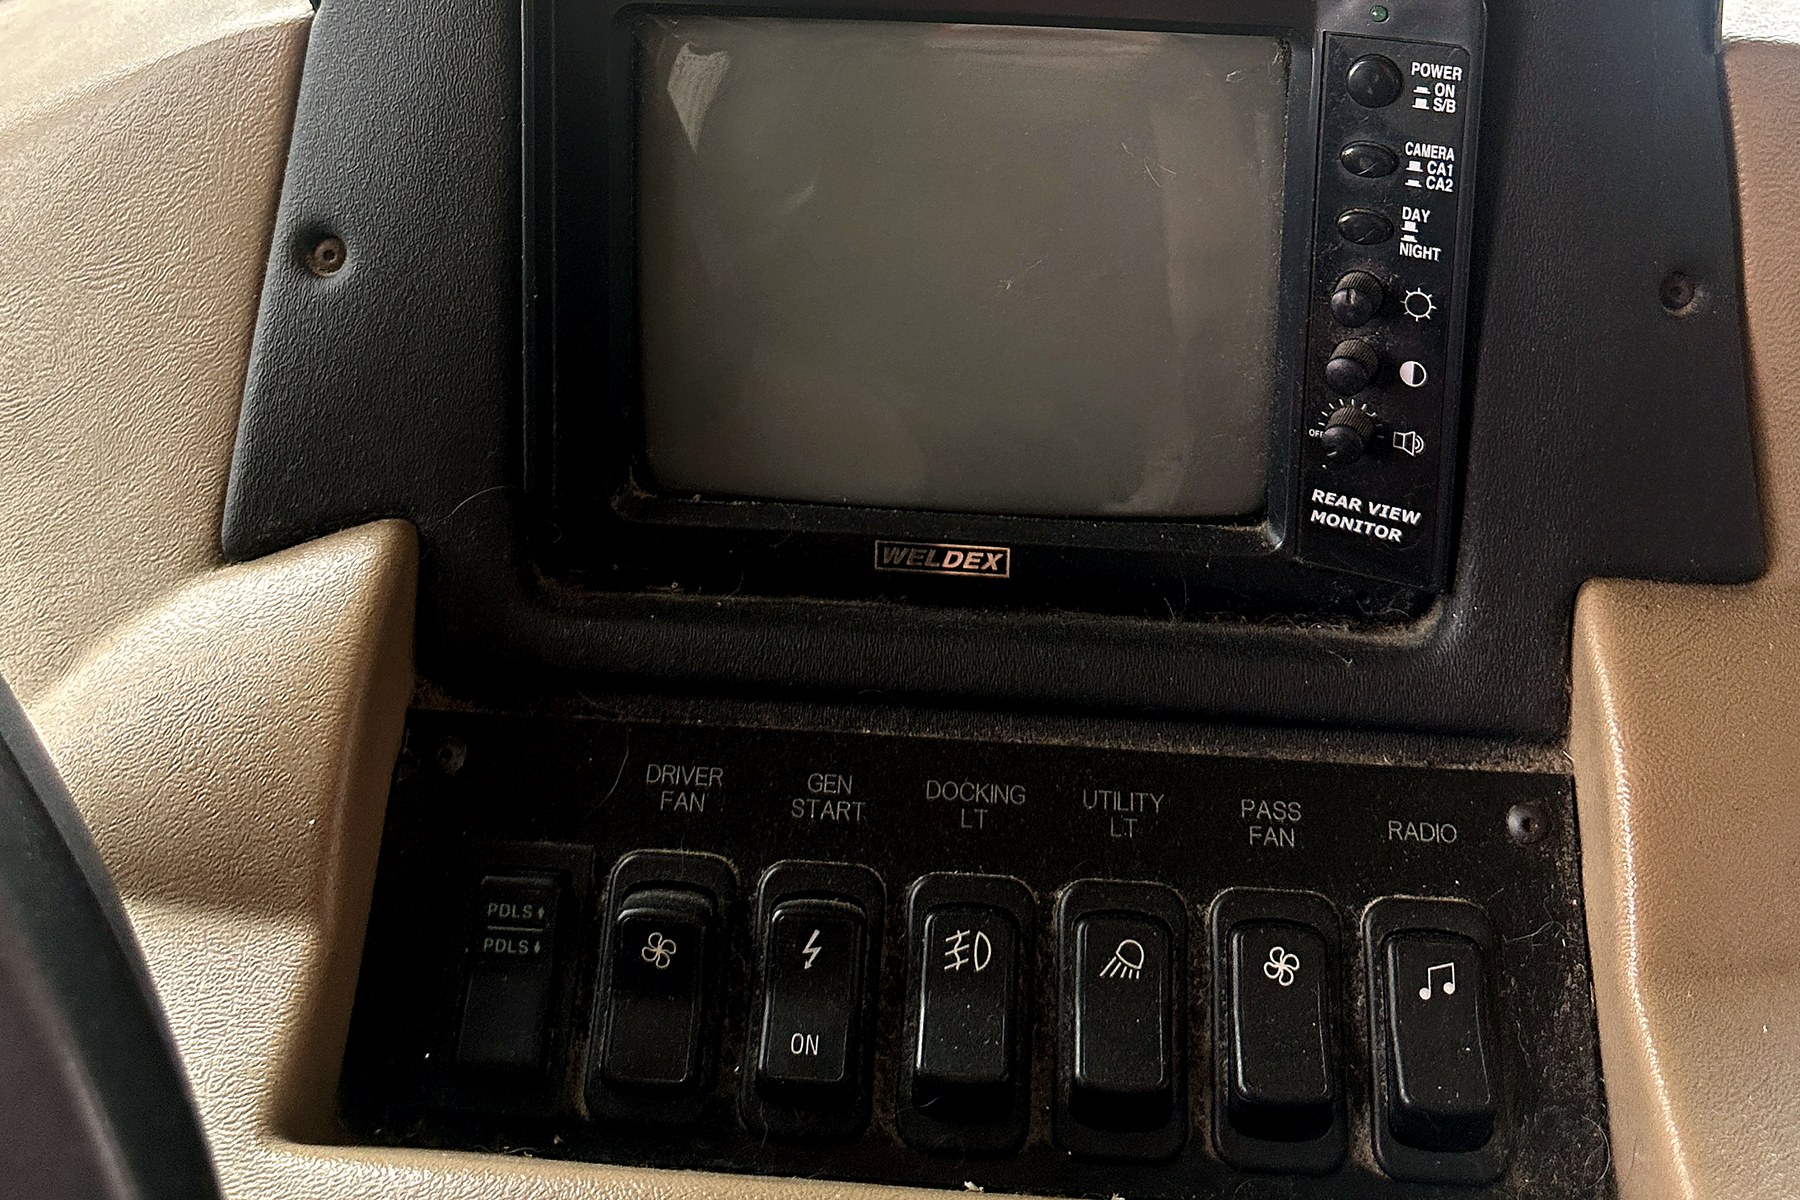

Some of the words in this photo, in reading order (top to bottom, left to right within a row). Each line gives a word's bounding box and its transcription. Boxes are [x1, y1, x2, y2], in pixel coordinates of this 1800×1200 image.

[1412, 62, 1462, 81] POWER
[1434, 82, 1455, 99] ON
[1433, 98, 1456, 113] S/B
[1405, 142, 1455, 162] CAMERA
[1427, 161, 1453, 177] CA1
[1426, 176, 1453, 192] CA2
[1402, 206, 1431, 223] DAY
[1399, 242, 1442, 262] NIGHT
[1312, 488, 1361, 511] REAR
[1368, 502, 1421, 525] VIEW
[1311, 509, 1403, 542] MONITOR
[883, 546, 1003, 570] WELDEX
[646, 764, 723, 786] DRIVER
[808, 773, 852, 794] GEN
[661, 791, 705, 812] FAN
[927, 780, 1025, 804] DOCKING
[1084, 790, 1164, 812] UTILITY
[791, 798, 865, 822] START
[961, 808, 988, 829] LT
[1242, 800, 1301, 822] PASS
[1111, 818, 1137, 838] LT
[1250, 826, 1294, 847] FAN
[1389, 821, 1456, 842] RADIO
[791, 1032, 819, 1056] ON
